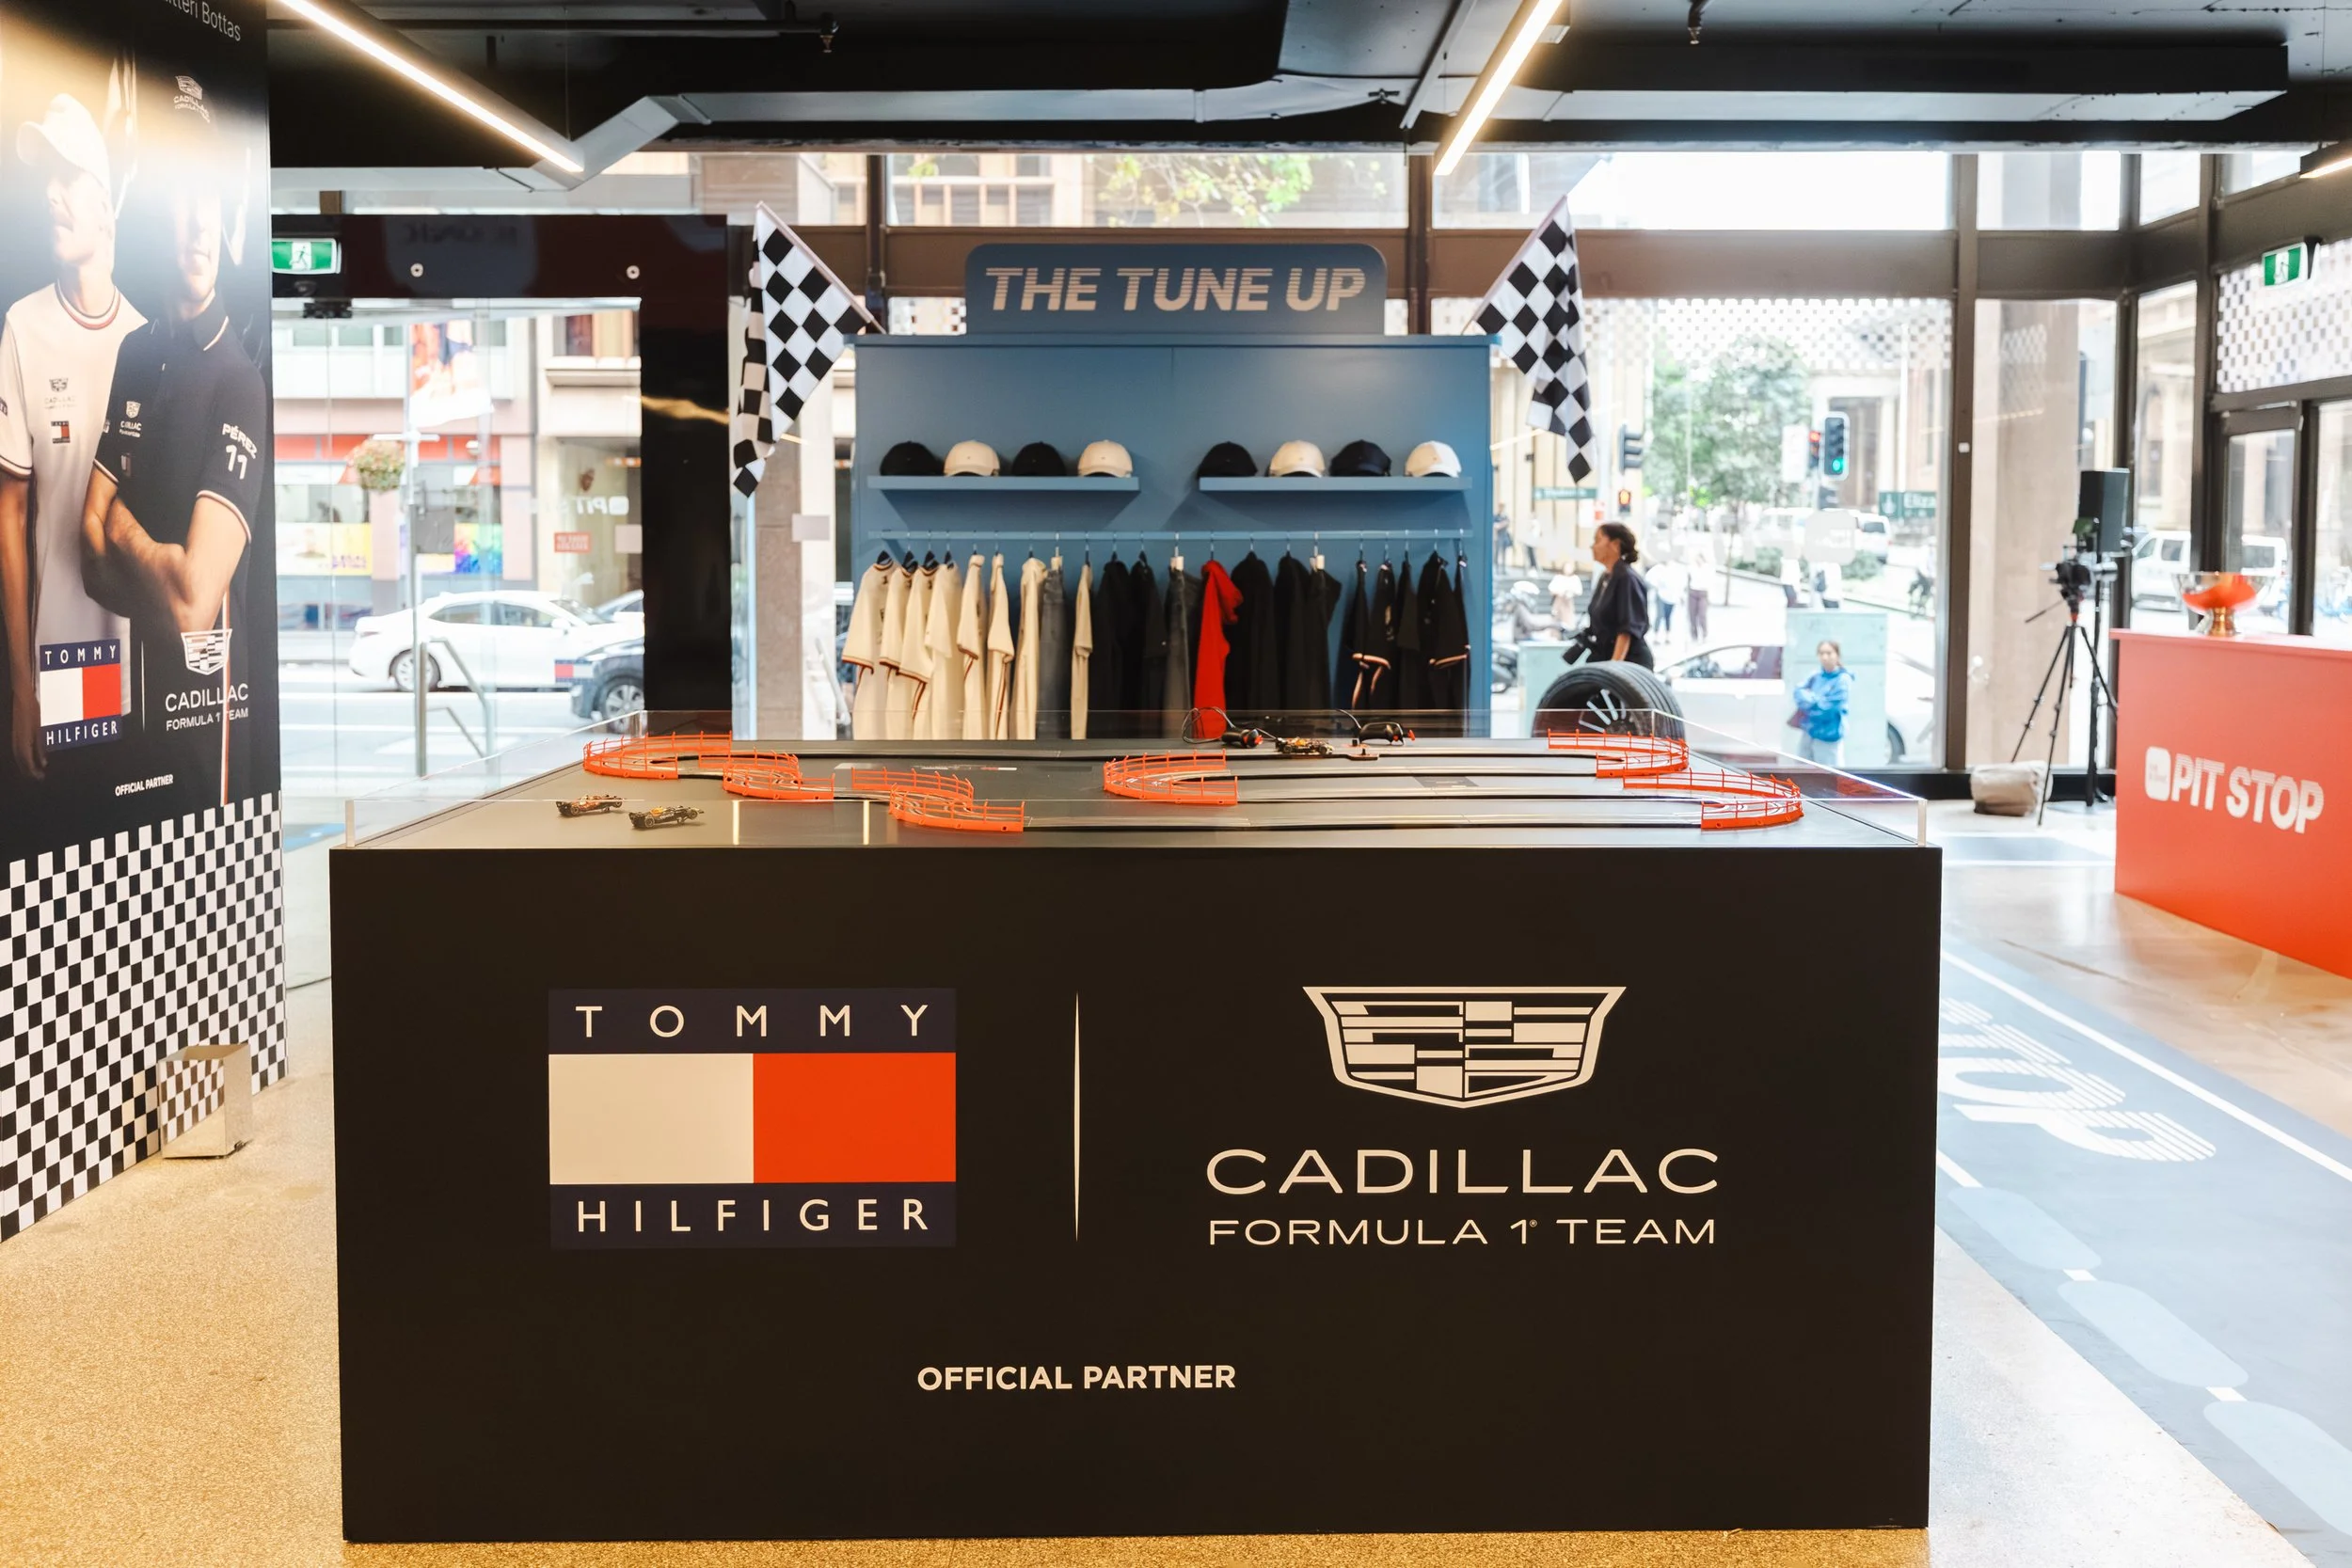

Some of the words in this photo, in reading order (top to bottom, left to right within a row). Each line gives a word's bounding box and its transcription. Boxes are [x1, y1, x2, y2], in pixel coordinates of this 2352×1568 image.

[202, 1, 241, 41] Bottas
[986, 267, 1102, 311] THE
[1117, 267, 1274, 311] TUNE
[1285, 267, 1367, 311] UP
[222, 423, 258, 459] PÉREZ
[45, 645, 116, 665] TOMMY
[166, 683, 248, 712] CADILLAC
[46, 721, 118, 745] HILFIGER
[166, 713, 214, 731] FORMULA
[115, 781, 145, 796] OFFICIAL
[145, 774, 173, 789] PARTNER
[2171, 753, 2225, 811] PIT
[2226, 767, 2325, 834] STOP
[576, 1005, 929, 1037] TOMMY
[1207, 1148, 1719, 1195] CADILLAC
[578, 1199, 929, 1231] HILFIGER
[1210, 1219, 1488, 1245] FORMULA
[1556, 1219, 1715, 1244] TEAM
[917, 1367, 1073, 1390] OFFICIAL
[1084, 1365, 1236, 1389] PARTNER
